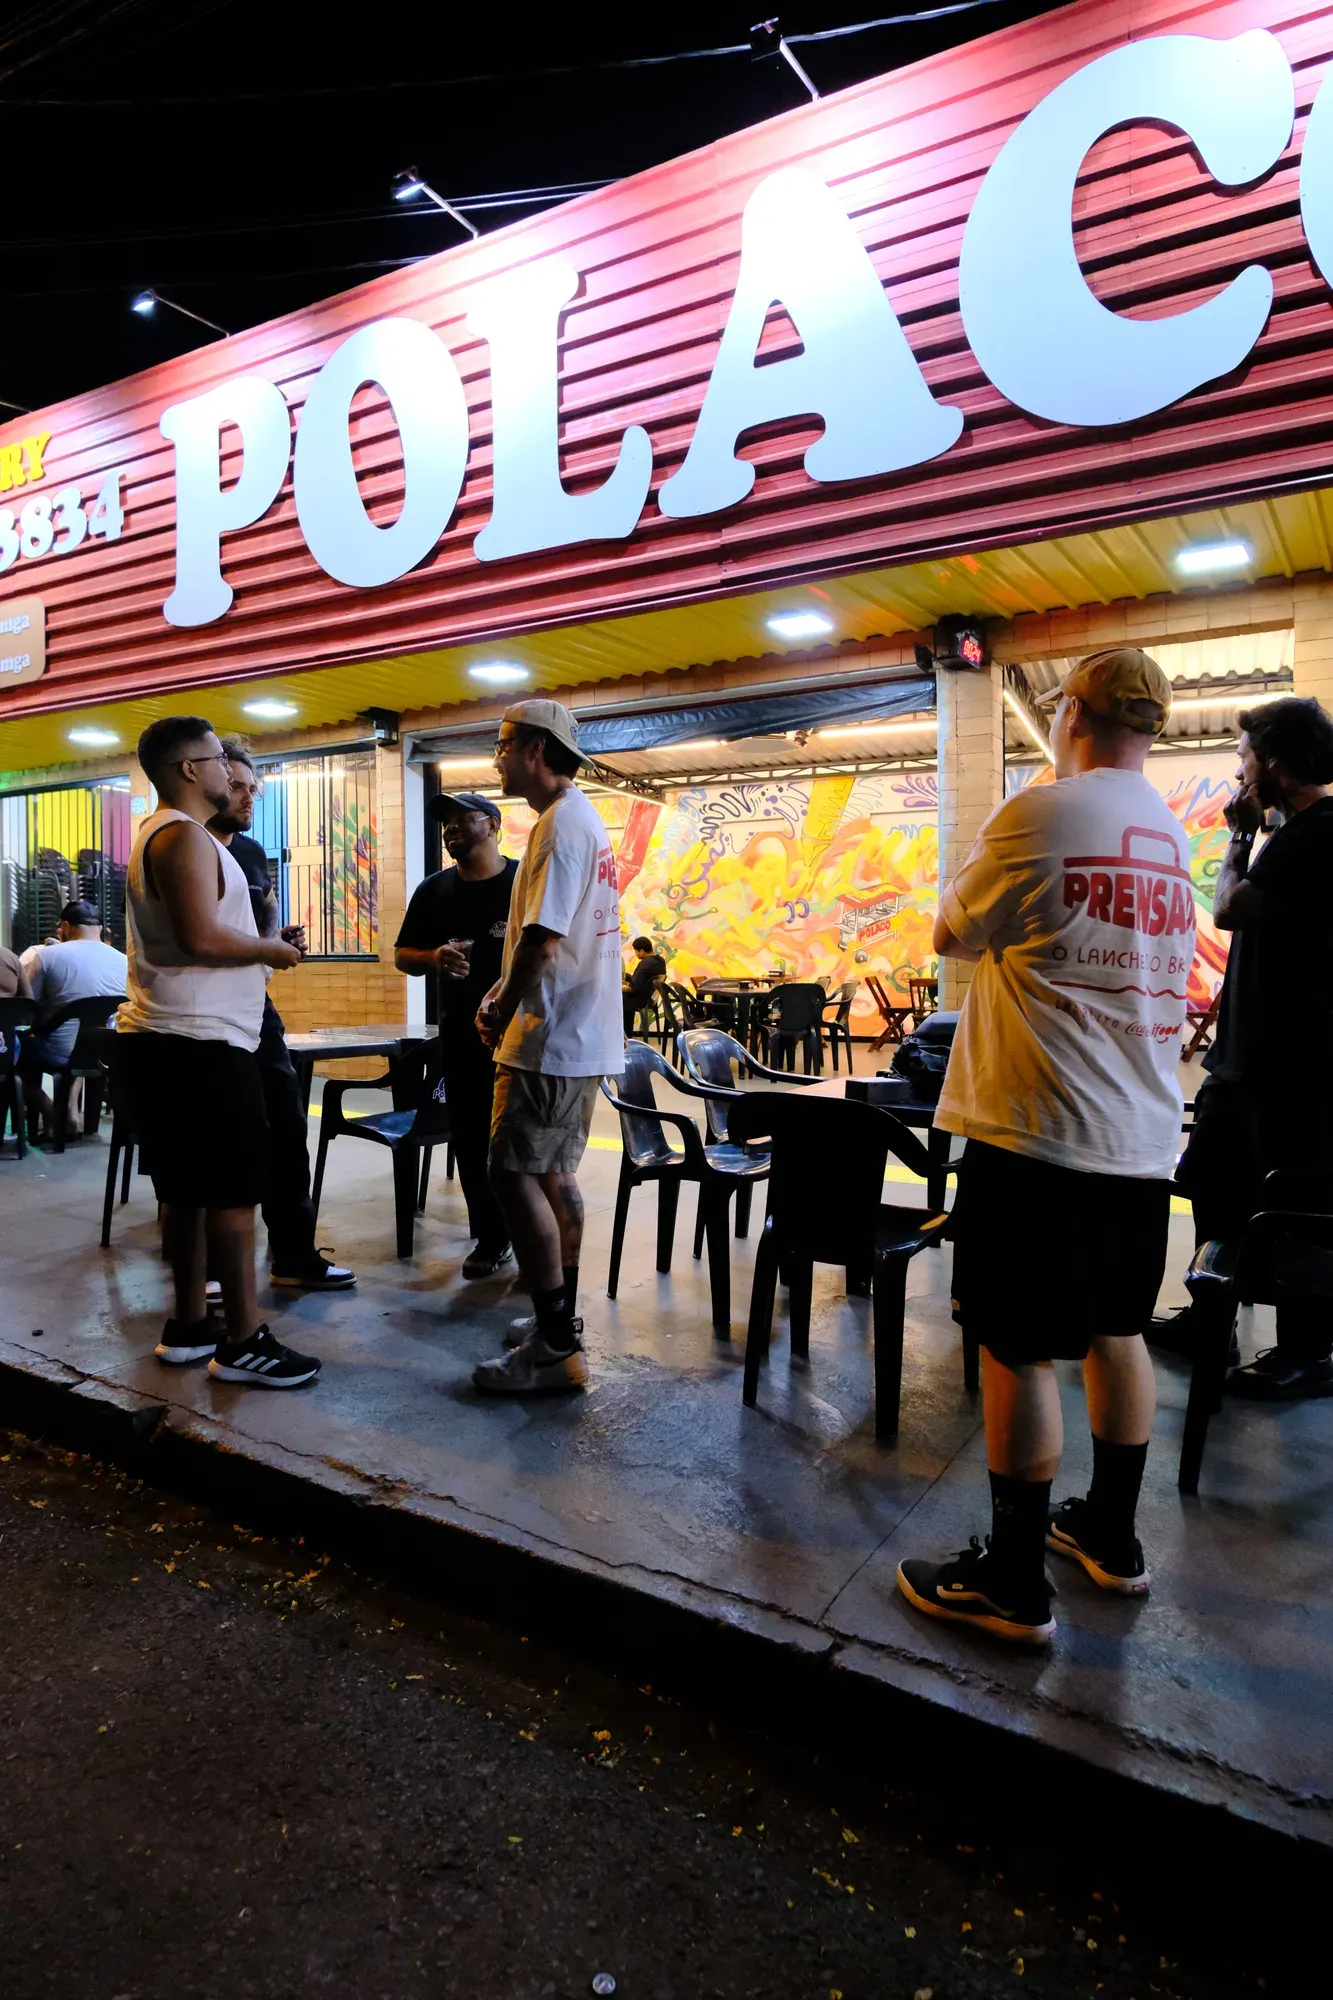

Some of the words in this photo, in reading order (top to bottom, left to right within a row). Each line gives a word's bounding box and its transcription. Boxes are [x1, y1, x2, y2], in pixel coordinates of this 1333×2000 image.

[160, 28, 1333, 628] POLAC
[1062, 872, 1197, 937] PRENSAD
[1052, 946, 1068, 961] O
[1167, 955, 1187, 975] BR
